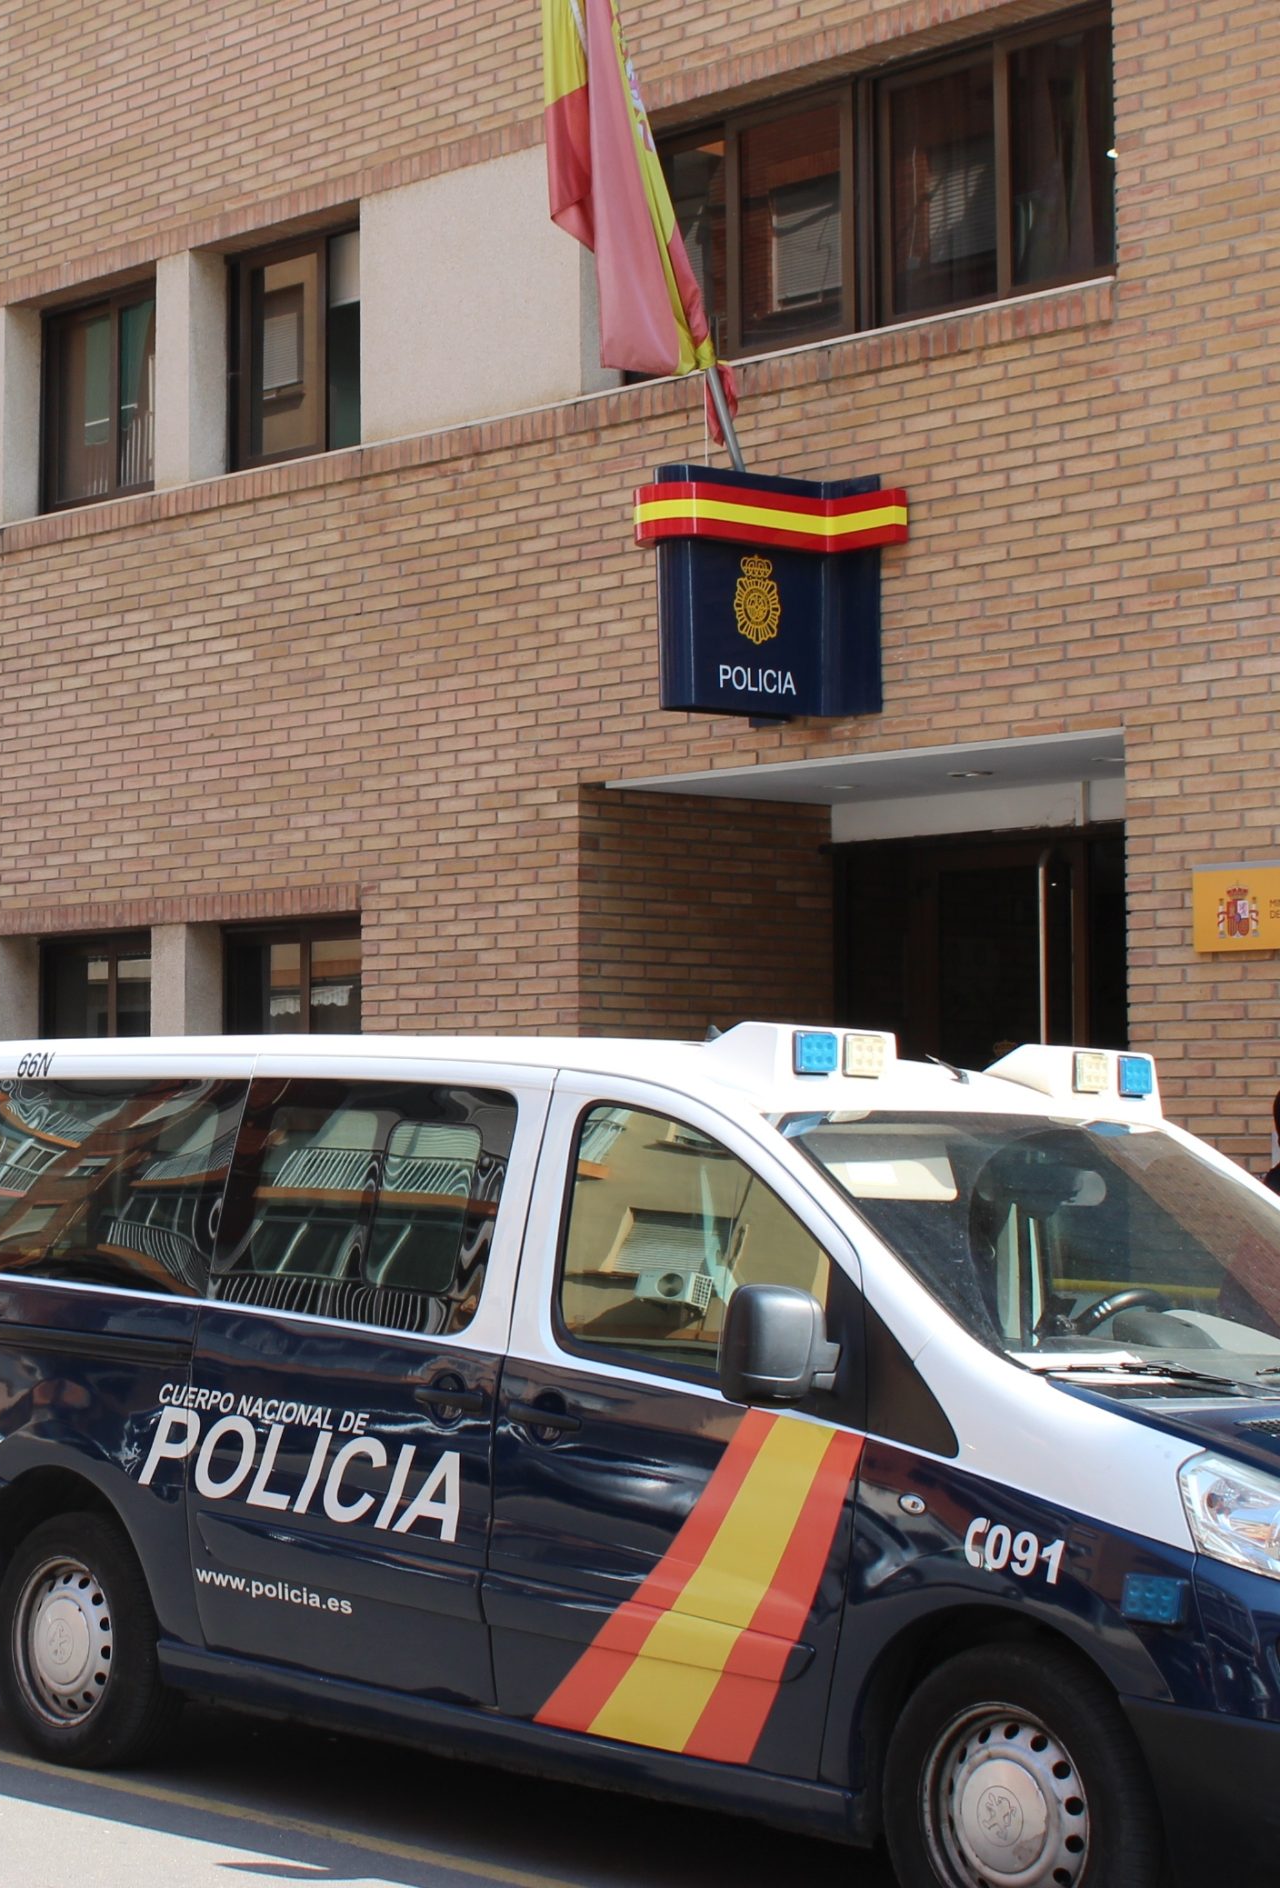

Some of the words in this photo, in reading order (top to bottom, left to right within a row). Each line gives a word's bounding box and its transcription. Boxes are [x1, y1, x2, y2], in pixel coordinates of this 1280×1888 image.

[719, 664, 797, 696] POLICIA
[17, 1051, 56, 1078] 66N
[158, 1383, 234, 1414] CUERPO
[236, 1394, 332, 1431] NACIONAL
[338, 1413, 370, 1434] DE
[137, 1405, 461, 1542] POLICIA
[195, 1567, 353, 1615] www.policia.es
